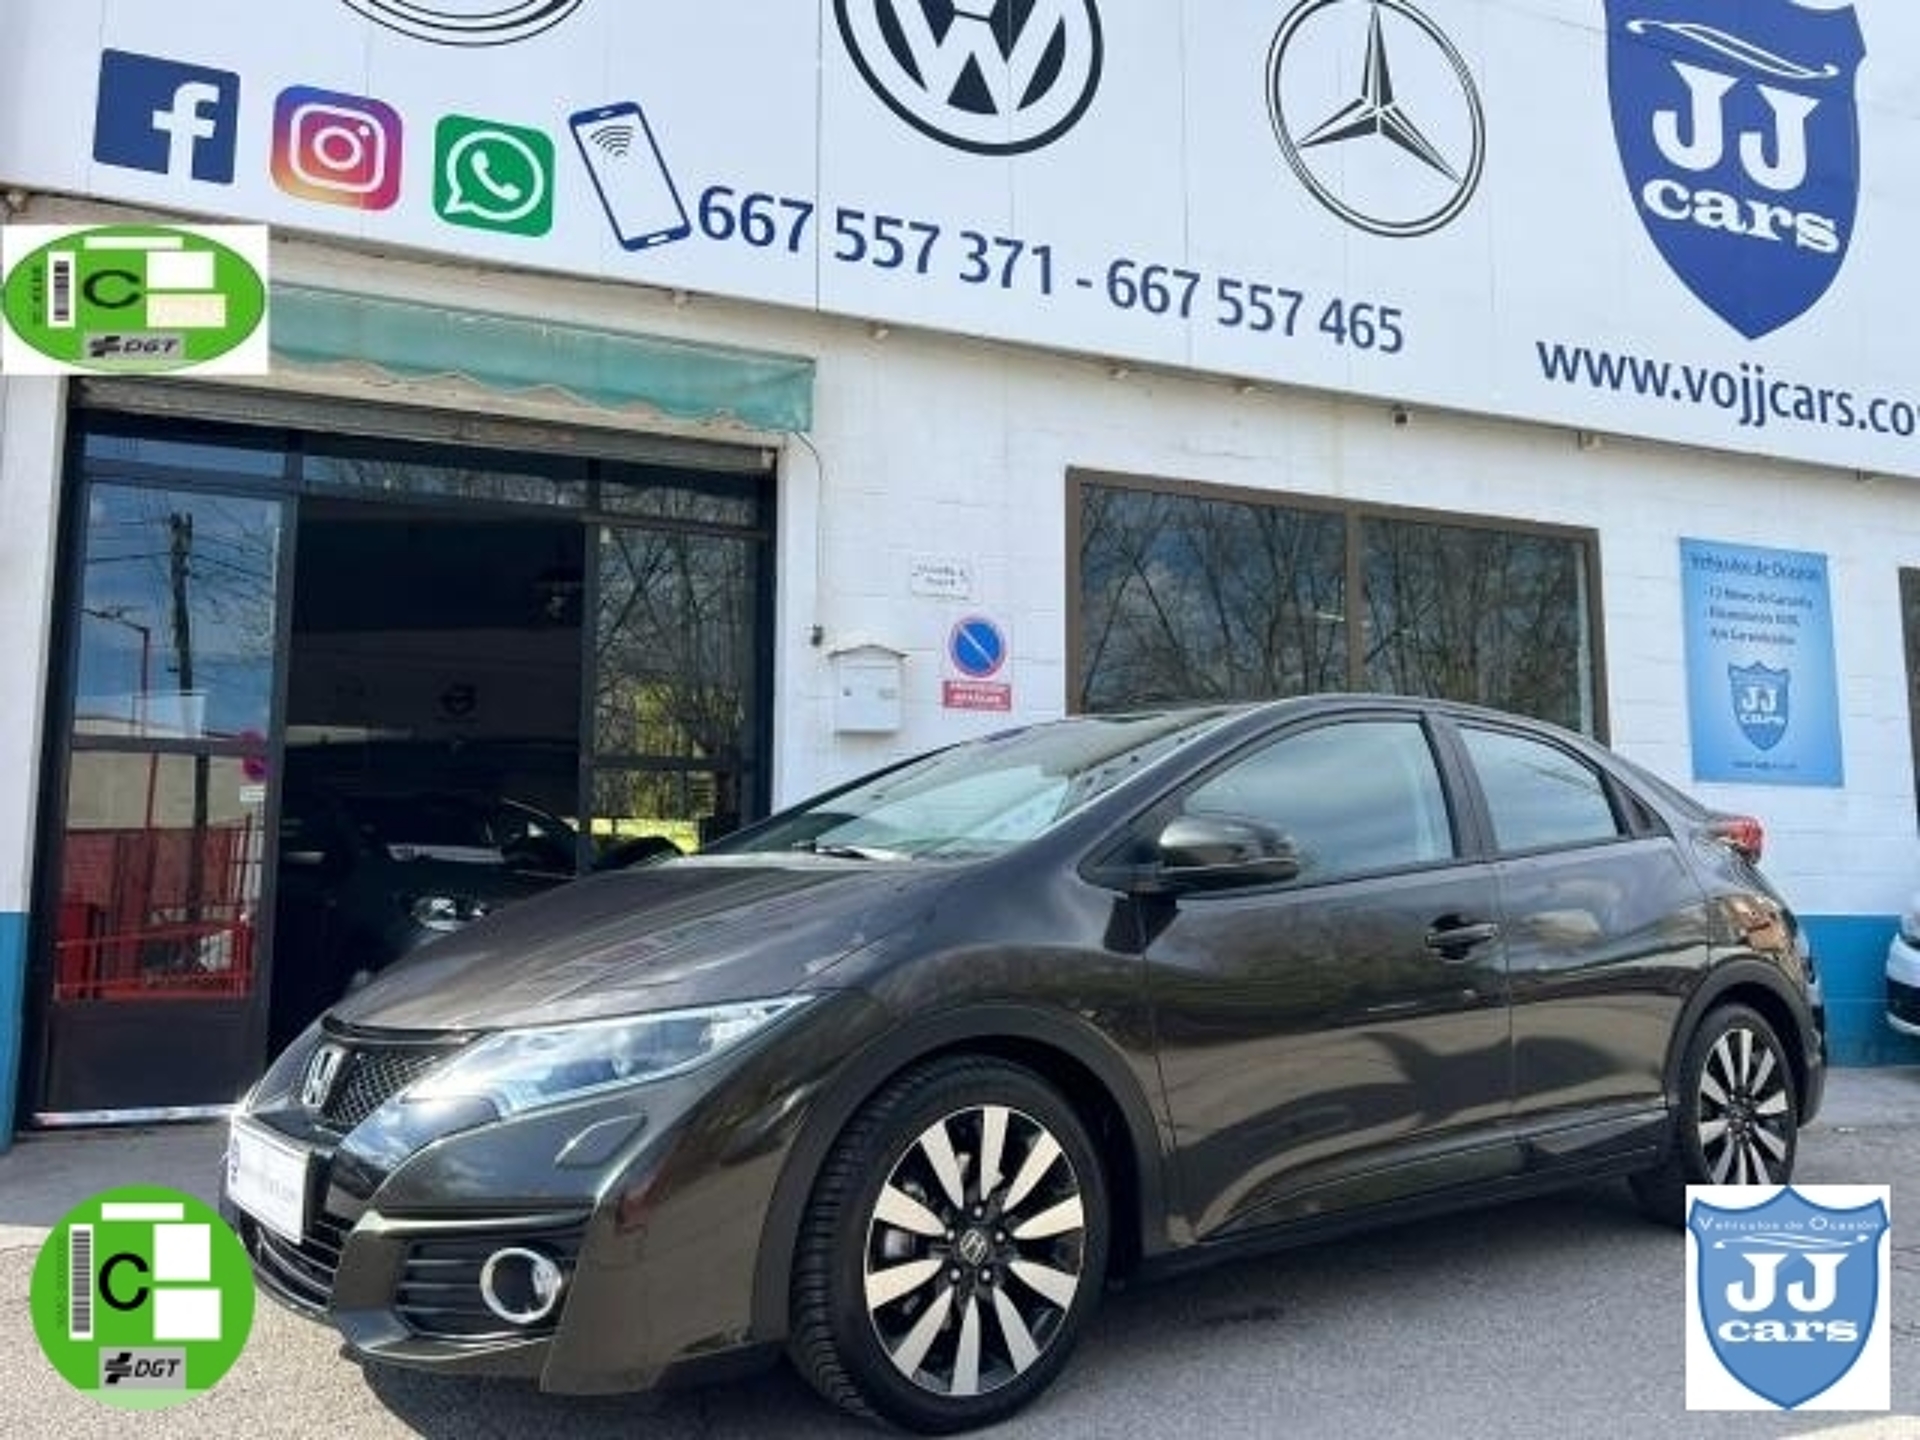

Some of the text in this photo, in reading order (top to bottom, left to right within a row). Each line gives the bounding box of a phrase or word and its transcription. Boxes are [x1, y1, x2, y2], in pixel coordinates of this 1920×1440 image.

[1652, 59, 1822, 191] JJ
[1642, 178, 1840, 254] cars
[698, 184, 814, 253] 667
[834, 207, 941, 275] 557
[958, 230, 1053, 296] 371
[1106, 258, 1202, 319] 667
[1216, 277, 1303, 338] 557
[1318, 297, 1404, 355] 465
[1536, 340, 1920, 437] www.vojjcars.co
[1741, 686, 1777, 712] JJ
